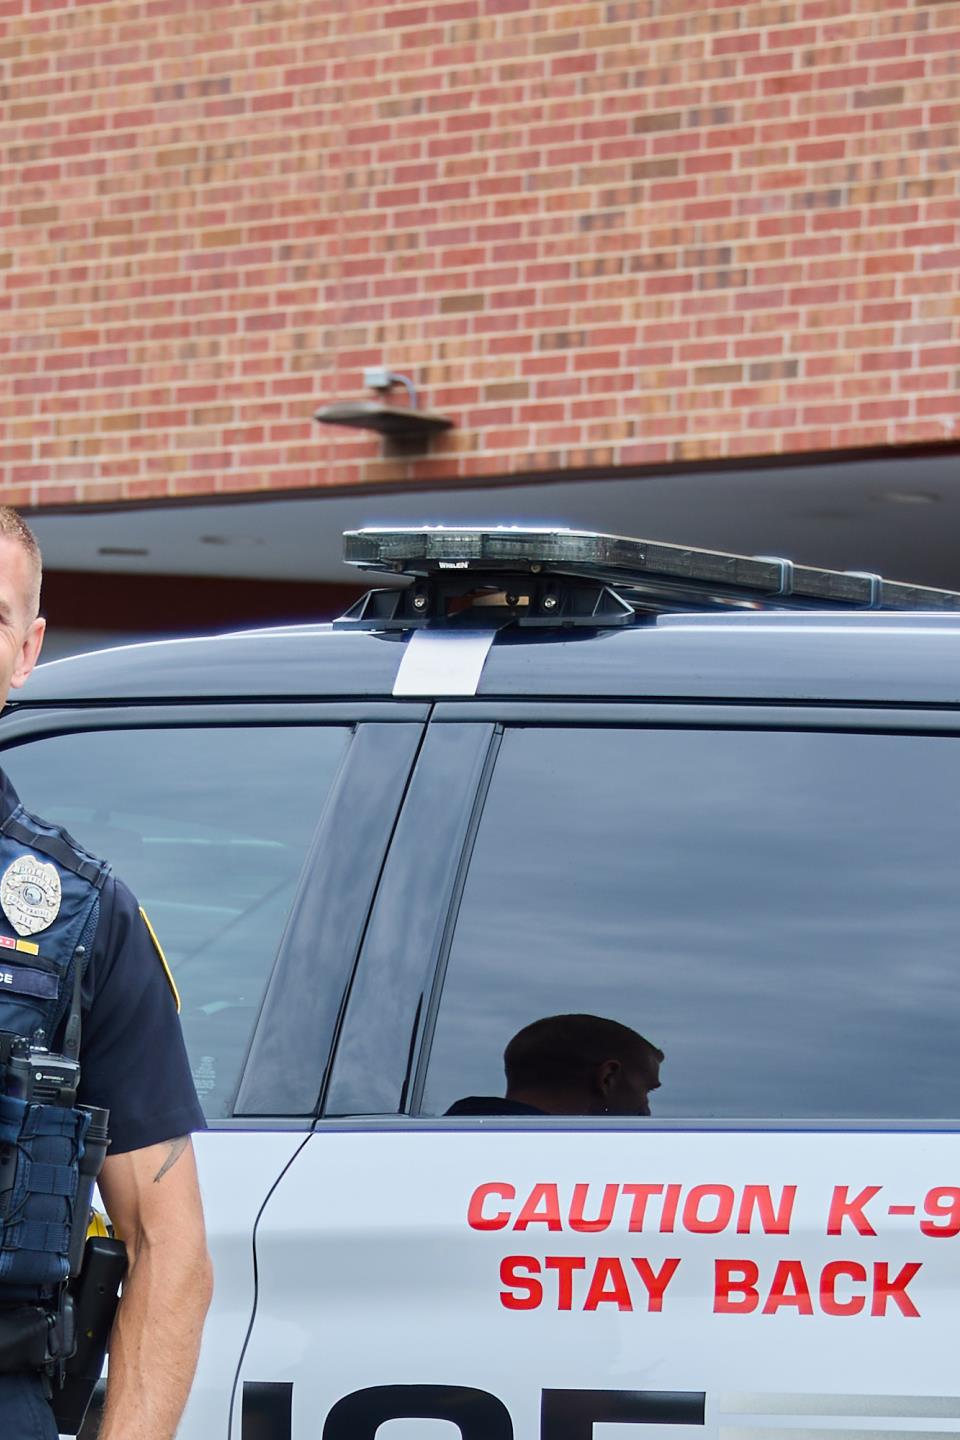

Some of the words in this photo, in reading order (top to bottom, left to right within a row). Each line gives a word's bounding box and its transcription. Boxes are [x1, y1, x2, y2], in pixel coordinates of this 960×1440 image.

[467, 1182, 798, 1235] CAUTION
[826, 1185, 960, 1239] K-9
[498, 1256, 682, 1313] STAY
[713, 1259, 923, 1318] BACK
